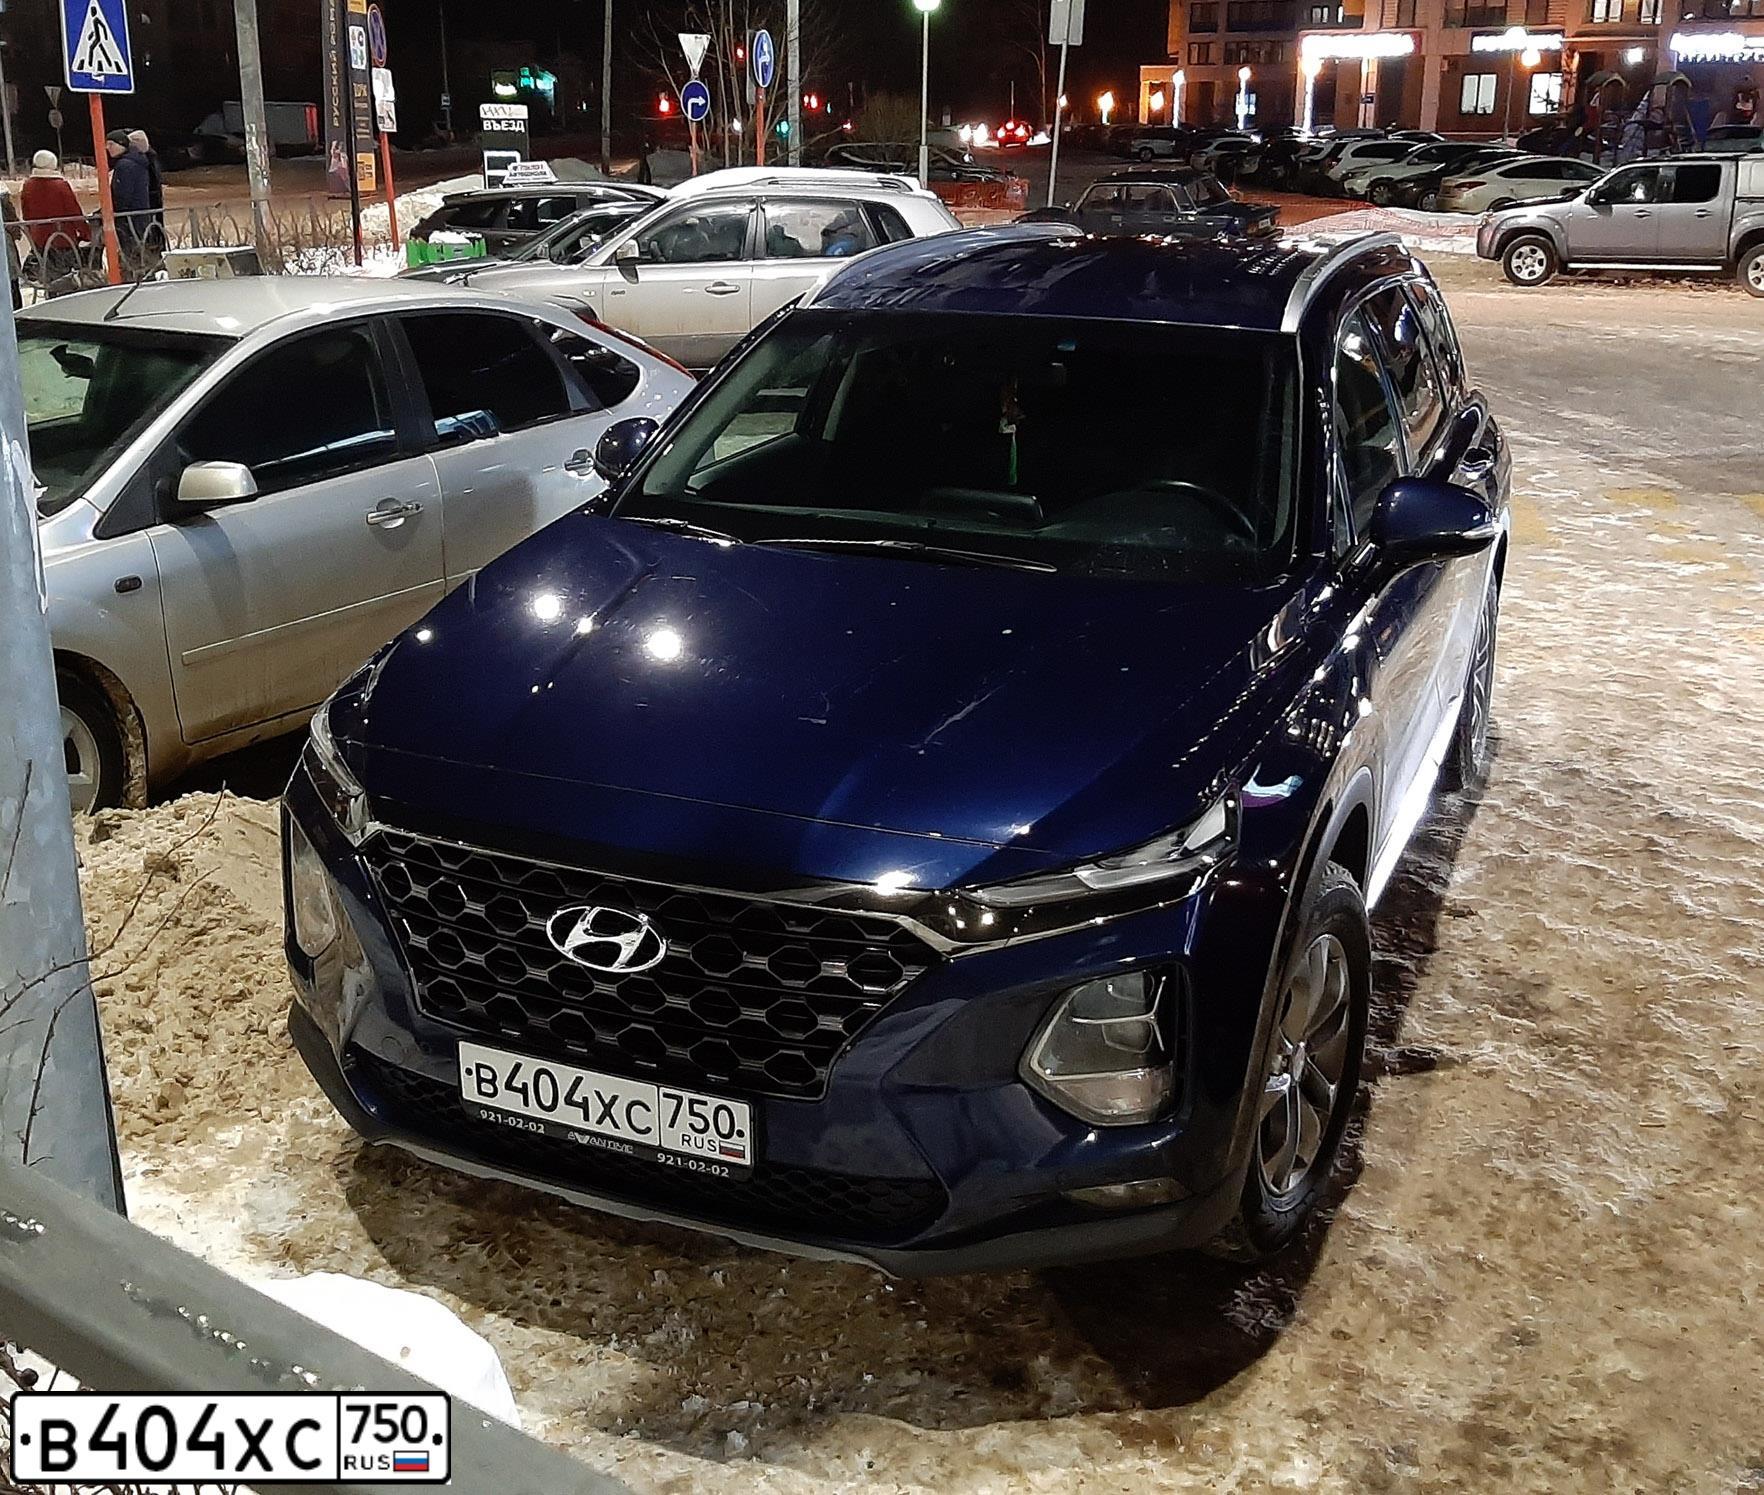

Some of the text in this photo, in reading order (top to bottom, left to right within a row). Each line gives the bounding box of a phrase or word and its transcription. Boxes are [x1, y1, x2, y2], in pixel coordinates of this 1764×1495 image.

[329, 51, 340, 127] РУССКИЙ
[483, 119, 525, 133] ВЪЕЗД
[662, 1091, 736, 1140] 750
[479, 1109, 546, 1134] 921-02-02
[656, 1152, 730, 1178] 921-02-02
[680, 1133, 718, 1153] RUS
